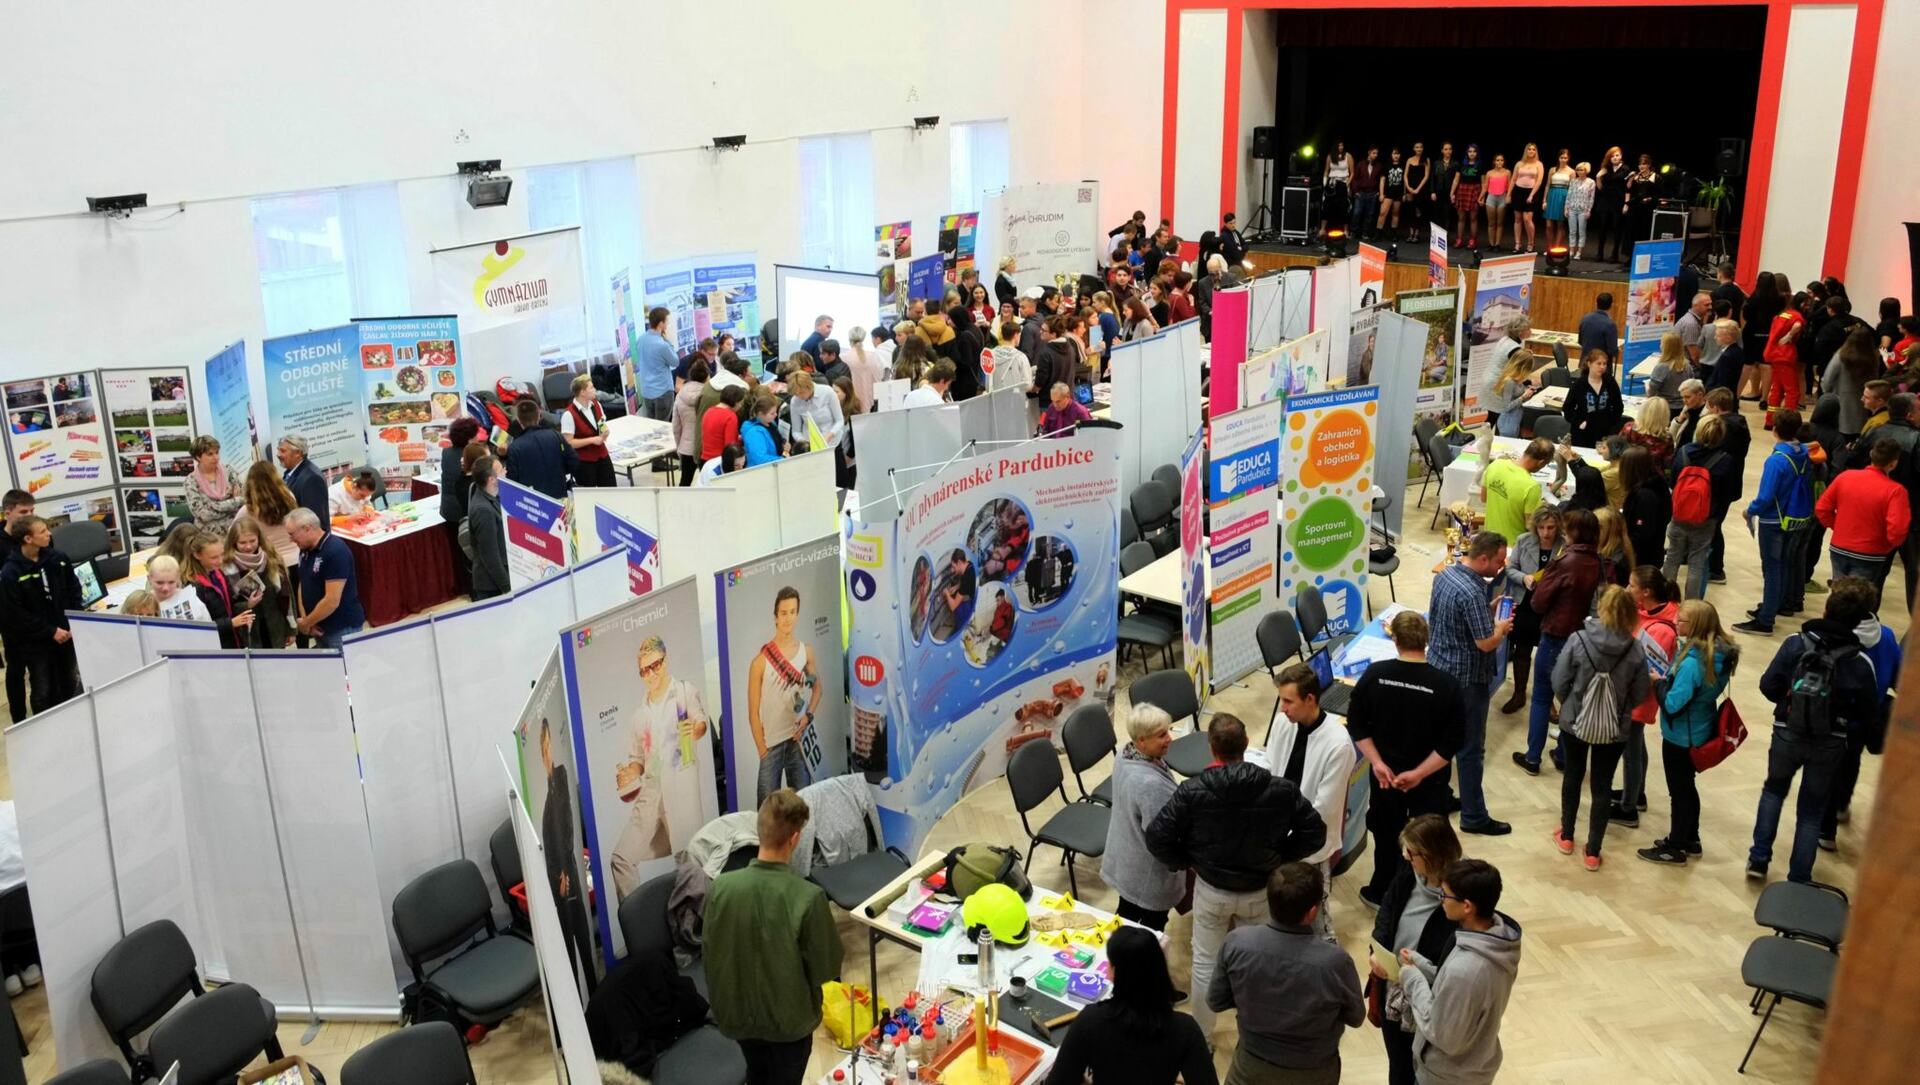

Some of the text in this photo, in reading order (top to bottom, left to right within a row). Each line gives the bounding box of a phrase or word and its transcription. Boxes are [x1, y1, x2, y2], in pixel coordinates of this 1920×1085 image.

[1028, 213, 1064, 224] CHRUDIM
[485, 278, 548, 307] GYMNÁZIUM
[1406, 297, 1450, 310] FLORISTIKA
[285, 338, 342, 364] STŘEDNÍ
[280, 355, 349, 382] ODBORNÉ
[287, 373, 344, 399] UČILIŠTĚ
[1291, 389, 1375, 408] EKONOMICKÉ VZDĚLÁVÁNÍ
[1317, 426, 1362, 441] Zahraniční
[1323, 440, 1355, 453] obchod
[1237, 450, 1271, 474] EDUCA
[1324, 452, 1360, 466] logistika
[1237, 466, 1271, 486] Pardubice
[919, 463, 993, 523] plynárenské
[999, 447, 1094, 479] Pardubice
[1305, 519, 1346, 535] Sportovní
[1297, 530, 1352, 547] management
[623, 603, 668, 632] Chemici
[599, 704, 618, 719] Denis
[1061, 934, 1069, 945] 4
[1096, 932, 1104, 945] 3
